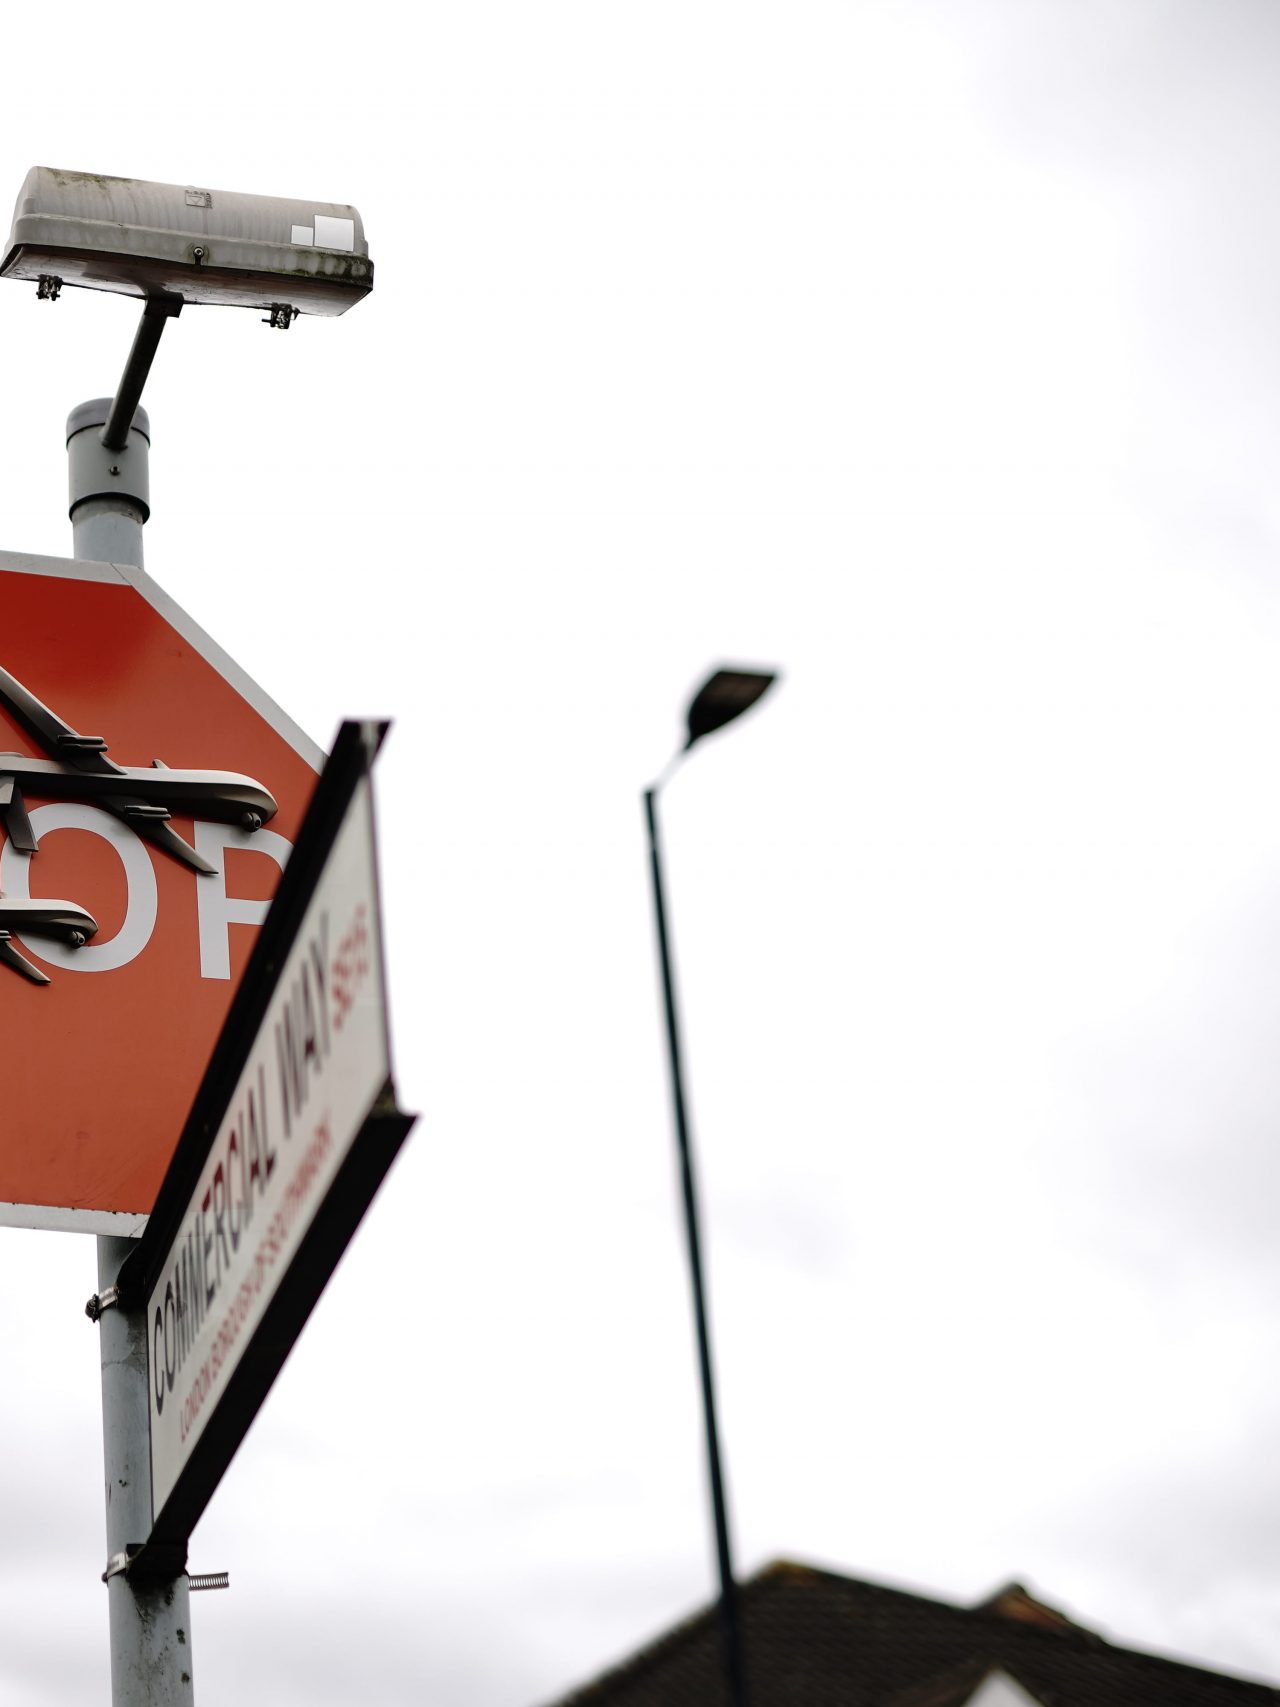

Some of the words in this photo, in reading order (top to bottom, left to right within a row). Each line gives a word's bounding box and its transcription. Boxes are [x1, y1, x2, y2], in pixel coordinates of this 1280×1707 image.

[154, 1064, 277, 1416] COMMERCIAL
[273, 911, 332, 1140] WAY
[179, 1361, 211, 1443] LONDON
